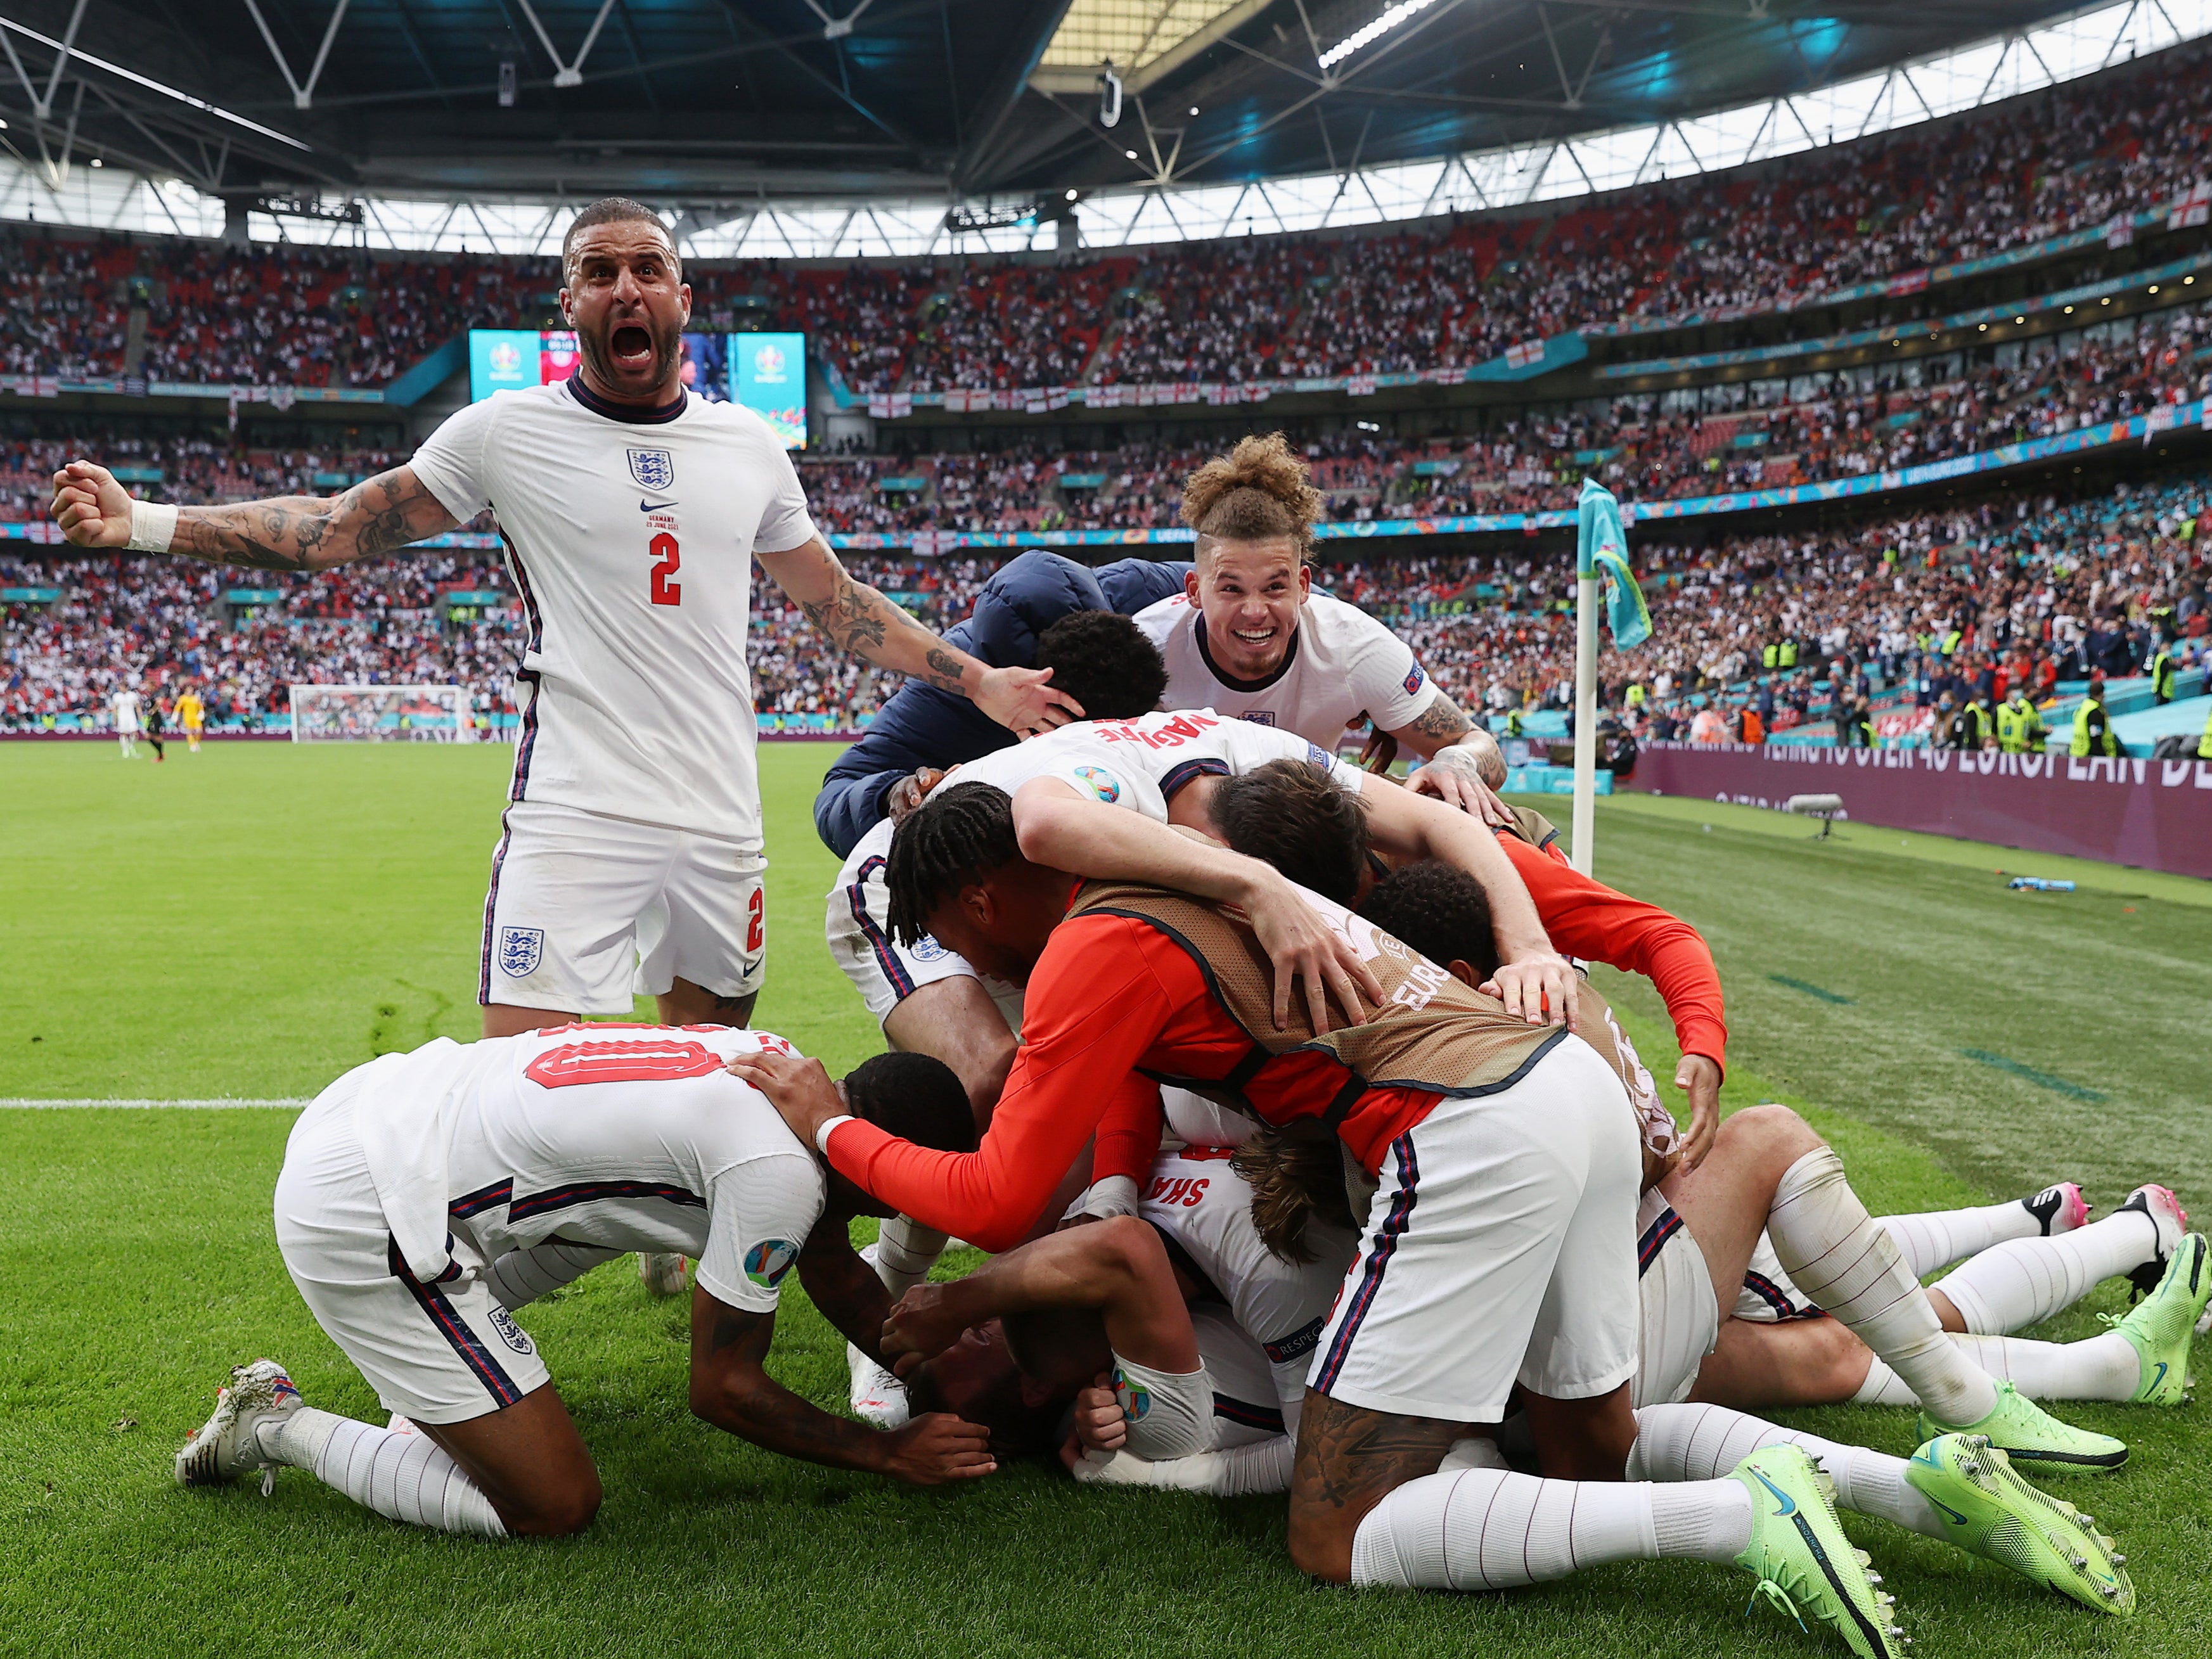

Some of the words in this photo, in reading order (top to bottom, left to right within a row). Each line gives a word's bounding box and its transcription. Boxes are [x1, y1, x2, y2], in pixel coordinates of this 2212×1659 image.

[649, 515, 674, 523] GERMANY
[650, 532, 681, 606] 2
[747, 887, 763, 953] 2
[1149, 1177, 1210, 1207] SHA
[1280, 1322, 1324, 1355] RESPECT
[1801, 1522, 1824, 1560] PHANTOM
